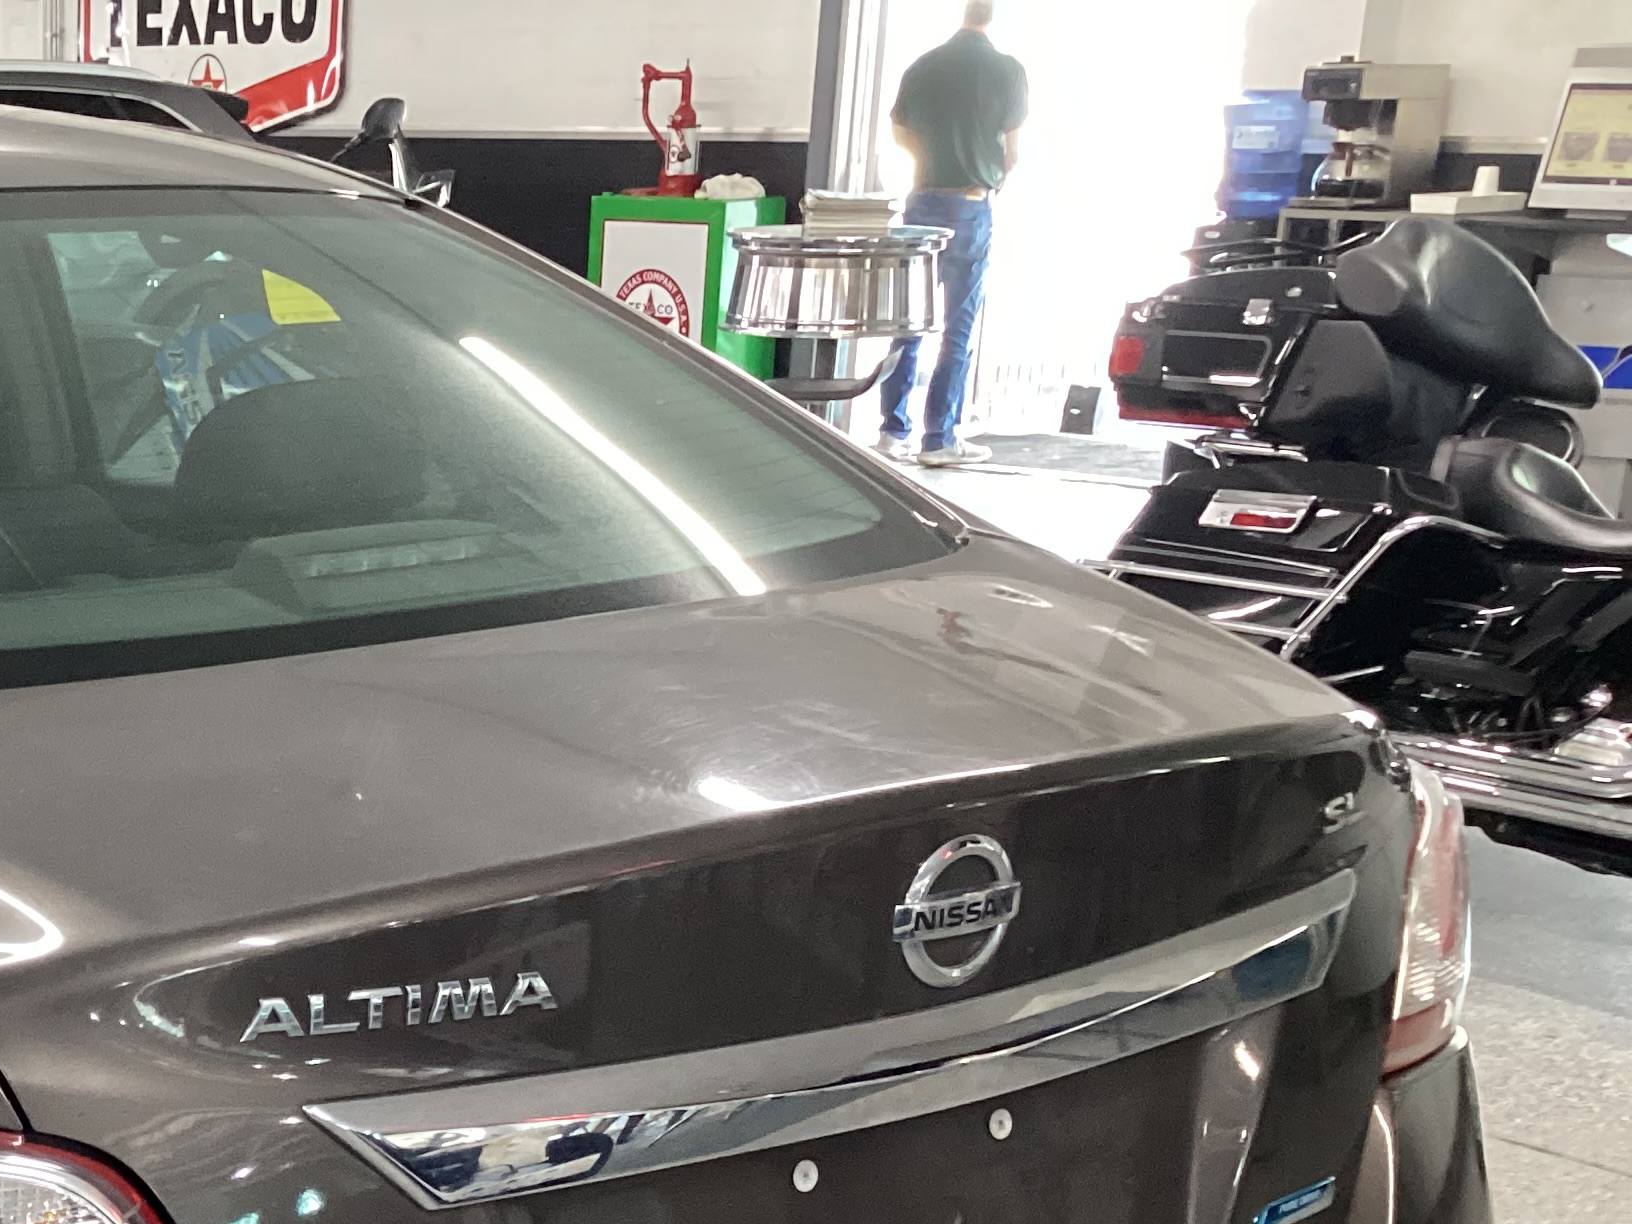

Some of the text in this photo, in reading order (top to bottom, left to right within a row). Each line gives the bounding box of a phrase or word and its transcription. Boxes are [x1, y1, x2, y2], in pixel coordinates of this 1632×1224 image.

[619, 274, 643, 299] TEXAS
[643, 271, 679, 294] COMPANY
[914, 892, 1012, 932] NISSA
[240, 972, 558, 1042] ALTIMA
